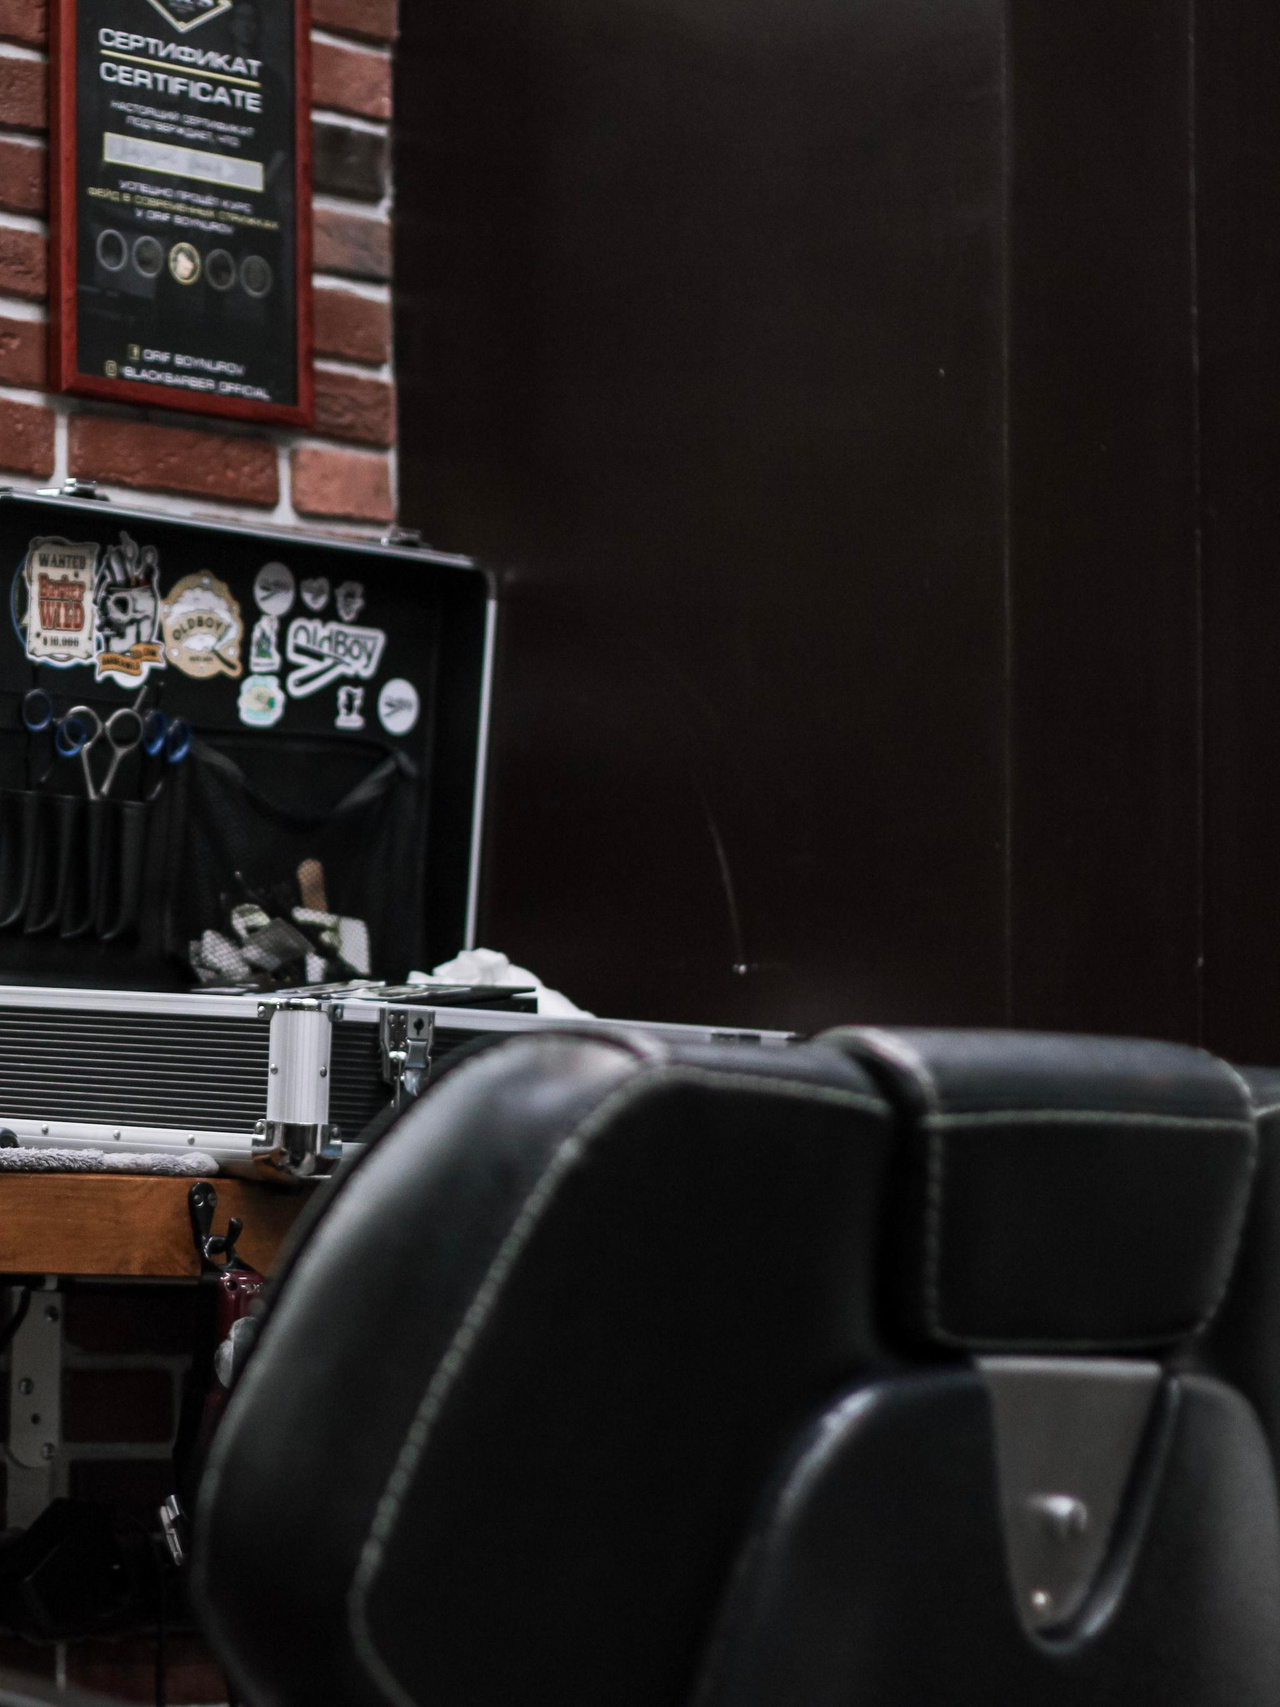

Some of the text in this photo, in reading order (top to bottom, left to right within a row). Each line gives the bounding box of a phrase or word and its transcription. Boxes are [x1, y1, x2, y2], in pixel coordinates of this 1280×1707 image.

[98, 28, 263, 77] СЕРТИФИКАТ
[99, 61, 263, 114] CERTIFICATE
[143, 348, 244, 376] ORIF BOYNUROV
[39, 552, 86, 570] WANTED
[172, 616, 224, 641] OLDBOY
